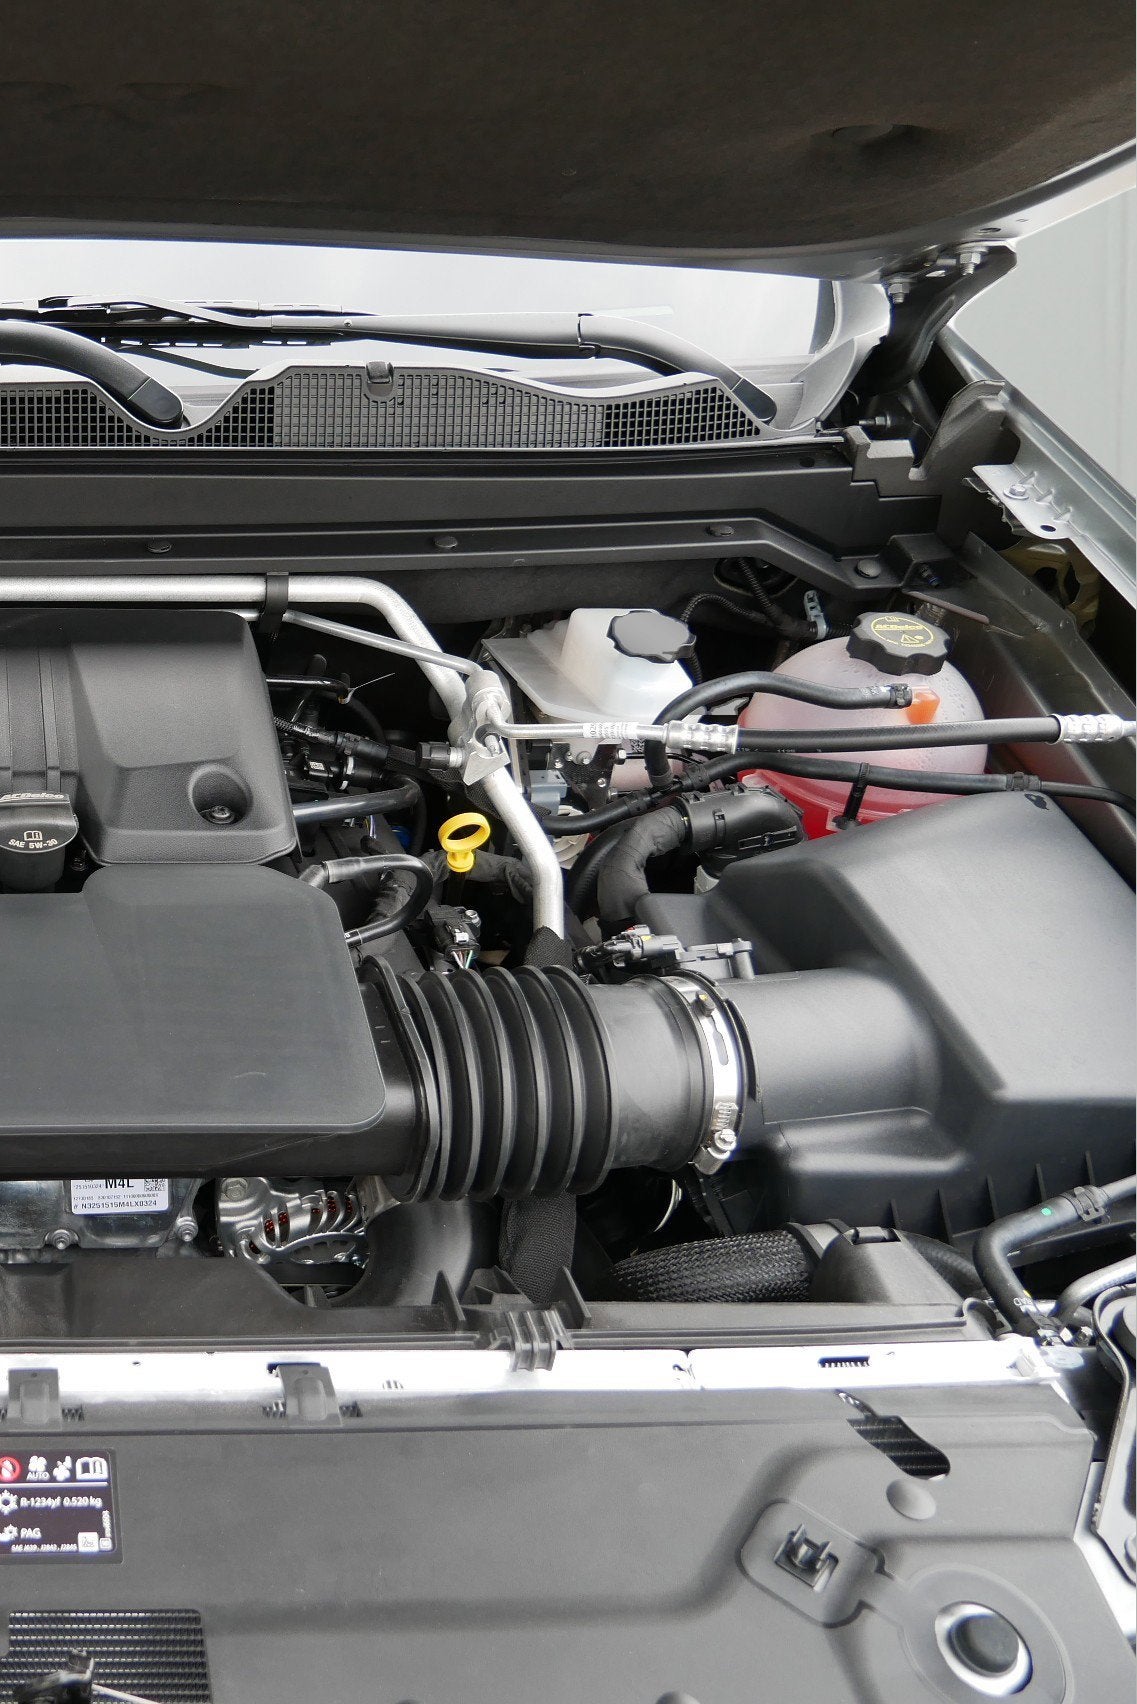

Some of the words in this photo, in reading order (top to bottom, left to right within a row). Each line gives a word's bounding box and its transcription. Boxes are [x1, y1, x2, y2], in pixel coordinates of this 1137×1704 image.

[8, 839, 25, 848] SAE
[29, 839, 58, 849] 5W-30
[105, 1179, 134, 1189] M4L
[26, 1472, 50, 1481] AUTO
[20, 1496, 61, 1510] R-1234yf
[63, 1496, 88, 1508] 0.520
[89, 1496, 103, 1509] kg
[20, 1528, 42, 1540] PAG
